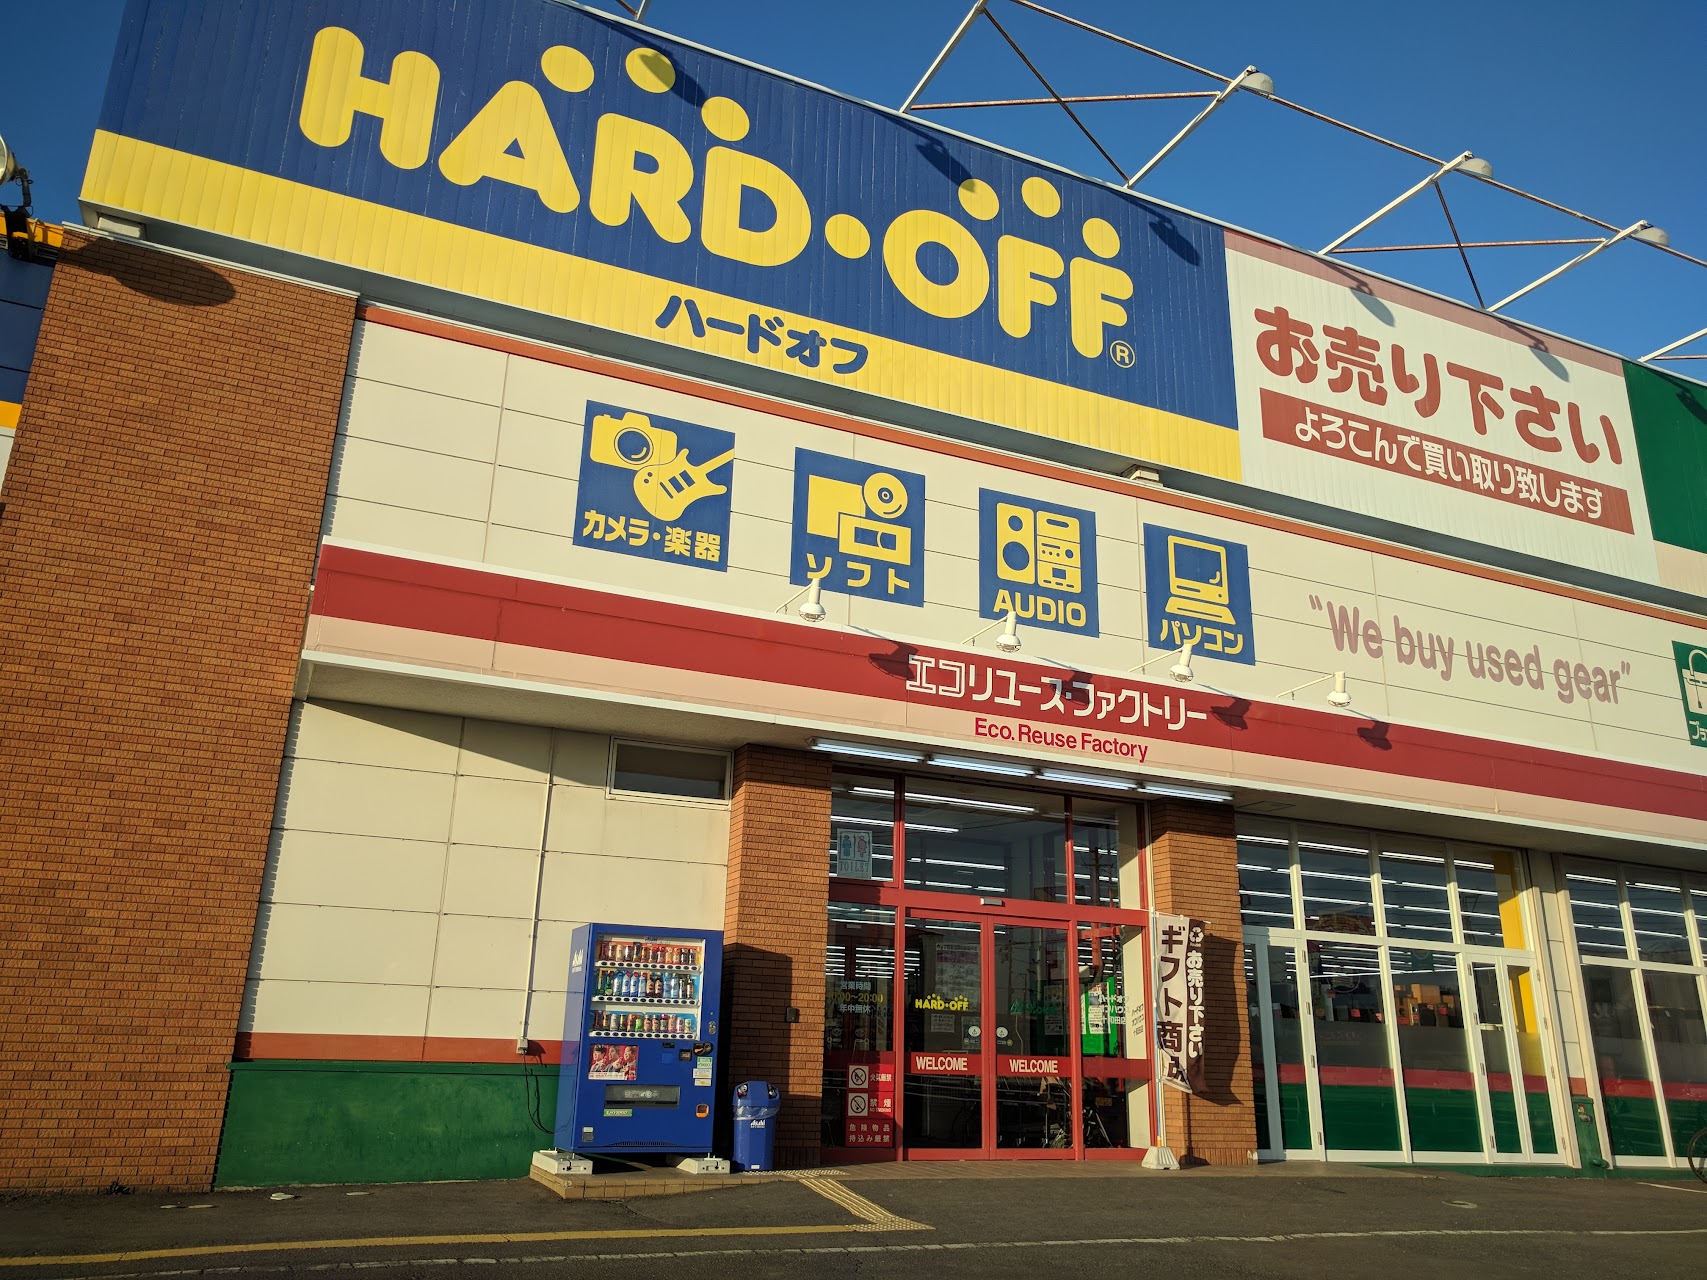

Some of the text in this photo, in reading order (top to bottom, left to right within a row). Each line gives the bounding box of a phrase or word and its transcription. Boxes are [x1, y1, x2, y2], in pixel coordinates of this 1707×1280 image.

[655, 295, 869, 374] ハードオフ
[1254, 306, 1623, 465] お売り下さい
[1295, 407, 1603, 519] よろこんで買い取り致します
[583, 509, 721, 563] カメラ・楽器
[806, 553, 910, 594] ソフト
[993, 589, 1087, 627] AUDIO
[1160, 619, 1244, 654] パソコン
[1393, 615, 1455, 681] buy
[1466, 640, 1545, 691] used
[974, 717, 1149, 763] Eco. Reuse Factory
[840, 861, 869, 873] TOILET
[840, 980, 872, 991] 営業時間
[1186, 950, 1205, 1059] お売り下さい
[839, 1003, 872, 1014] 年中無休
[916, 1056, 968, 1071] WELCOME
[1009, 1059, 1059, 1073] WELCOME
[849, 1123, 891, 1132] 危険物品
[849, 1134, 890, 1143] 持込み厳禁
